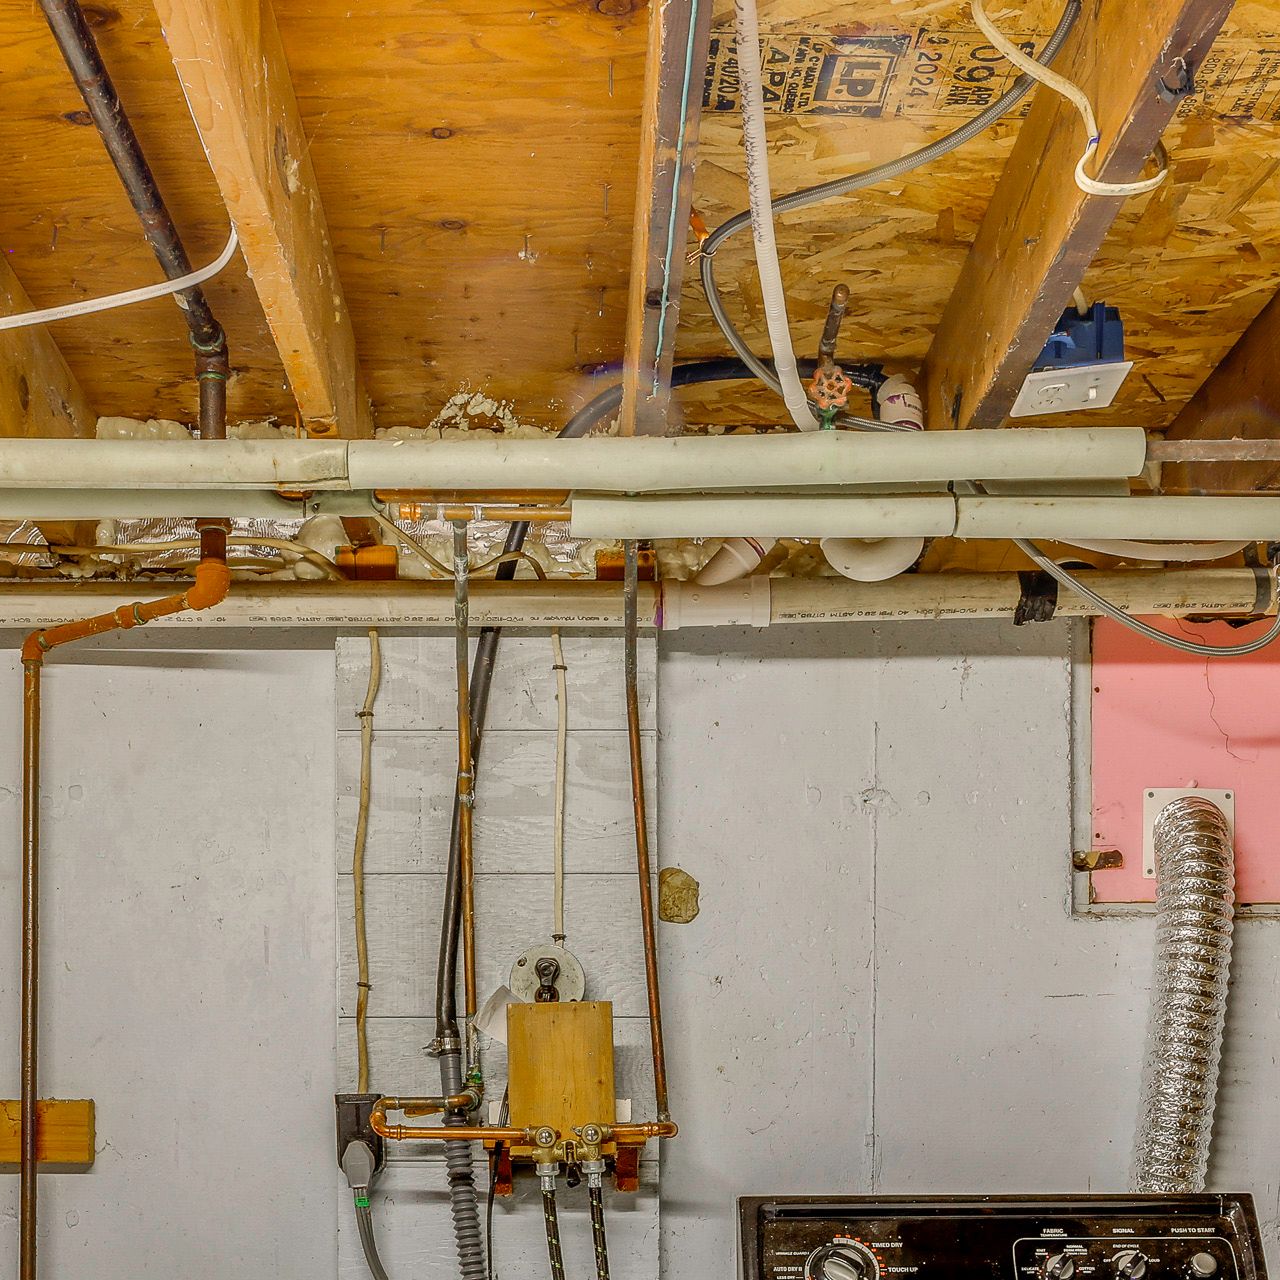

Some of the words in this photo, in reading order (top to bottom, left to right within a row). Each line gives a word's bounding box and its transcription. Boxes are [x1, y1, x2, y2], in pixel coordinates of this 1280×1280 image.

[758, 46, 791, 102] APA
[905, 51, 943, 97] 2024
[971, 85, 995, 106] APR
